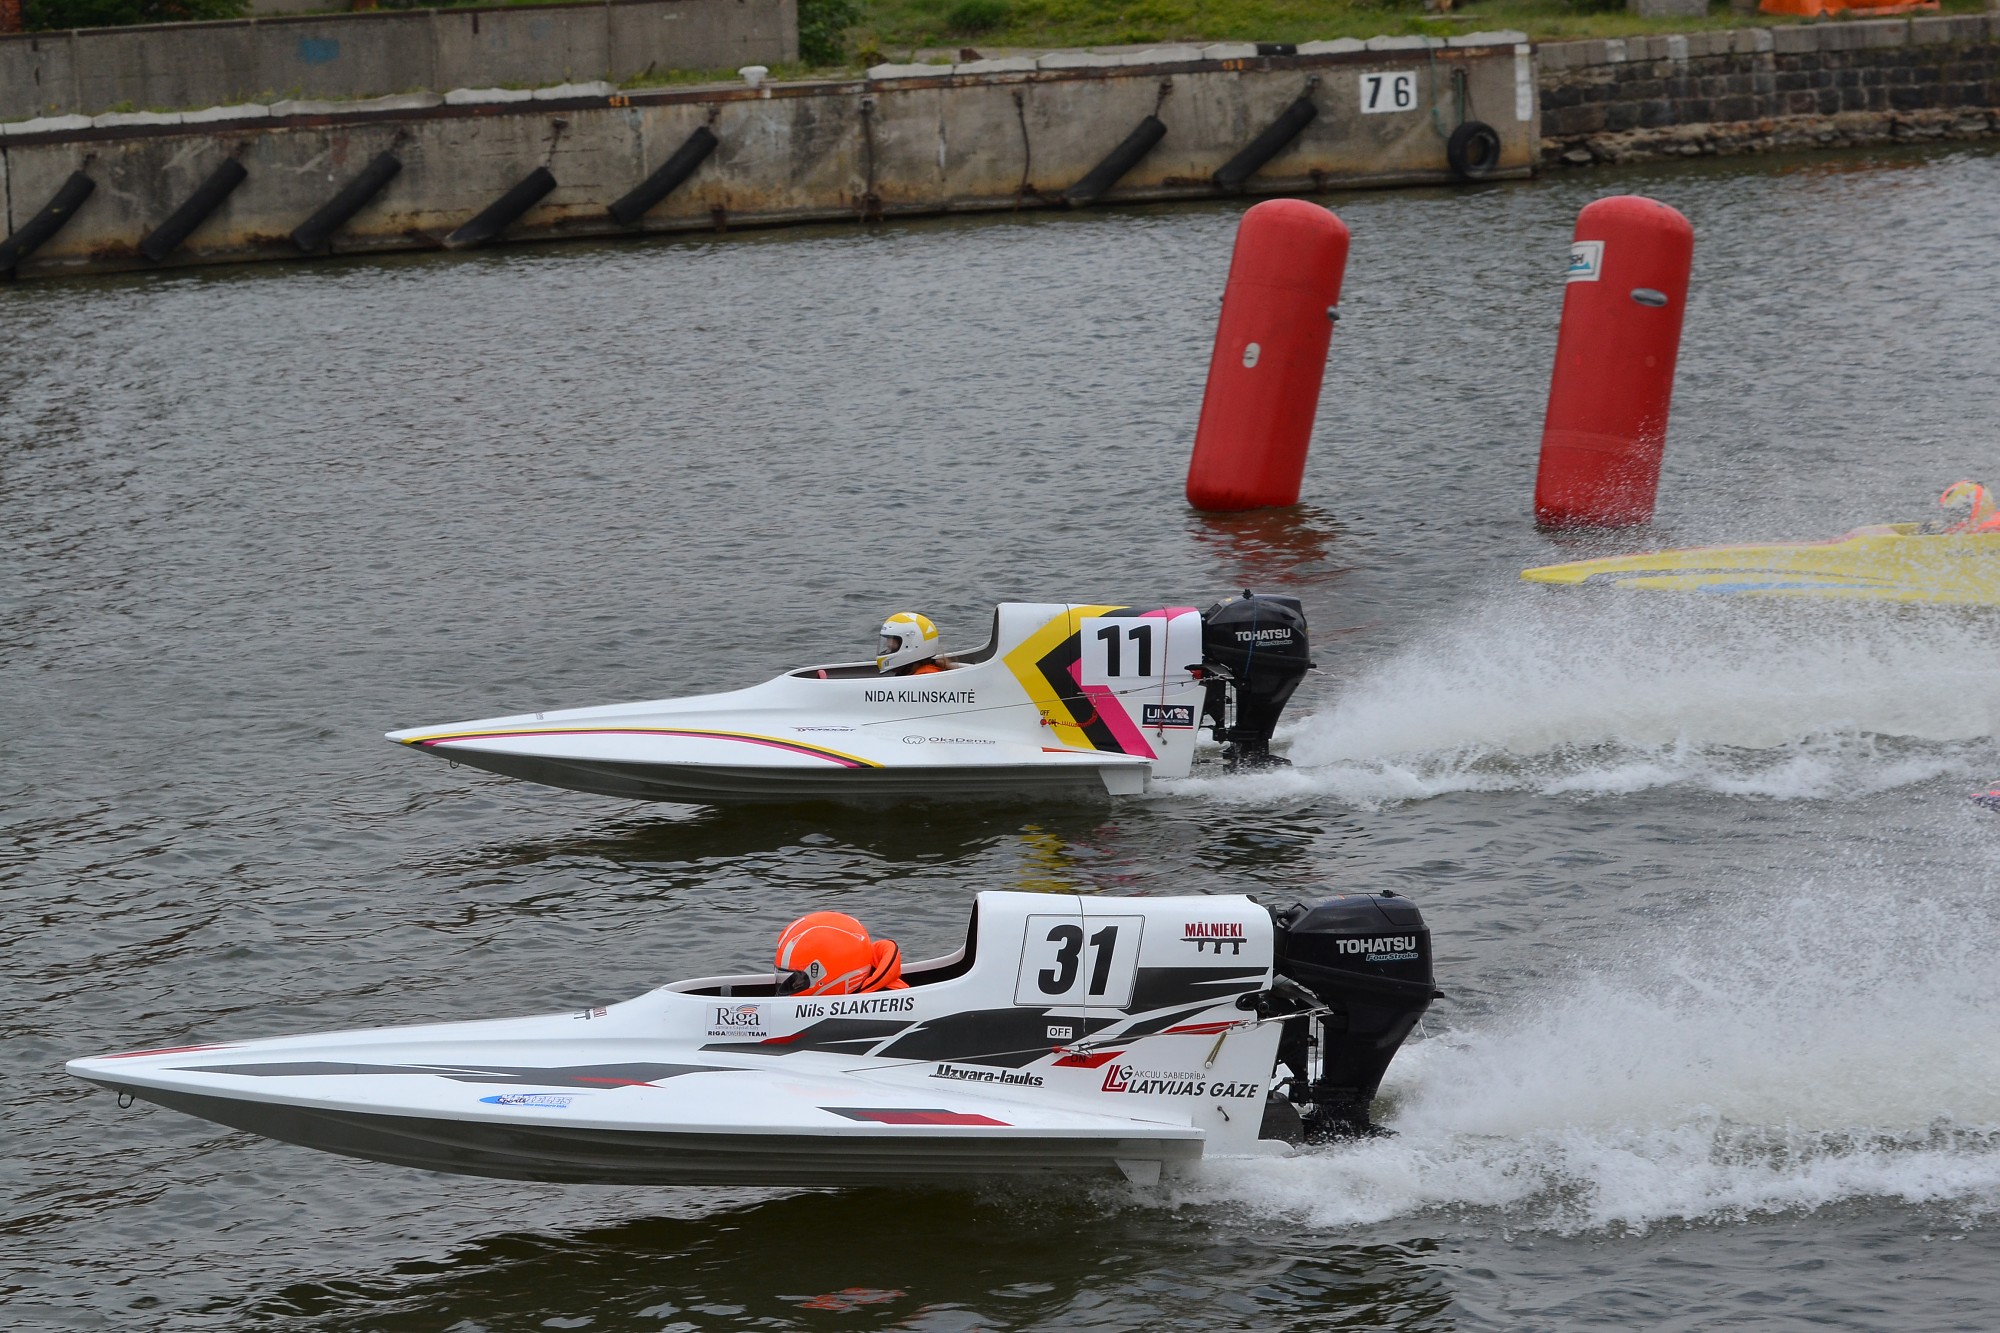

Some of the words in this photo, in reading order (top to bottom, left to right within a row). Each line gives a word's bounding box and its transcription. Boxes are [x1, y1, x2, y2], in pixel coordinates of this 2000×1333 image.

[1235, 628, 1291, 642] TOHATSU
[1097, 624, 1151, 677] 11
[864, 690, 895, 703] NIDA
[898, 688, 976, 704] KILINSKAITĖ
[1146, 707, 1174, 719] UIM
[1184, 921, 1243, 937] MĀLNIEKI
[1335, 935, 1416, 954] TOHATSU
[1037, 923, 1119, 996] 31
[1365, 951, 1419, 961] FourStroke
[795, 1003, 825, 1018] Nils
[829, 996, 915, 1016] SLAKTERIS
[1049, 1027, 1071, 1037] OFF
[1070, 1054, 1087, 1064] ON
[936, 1063, 1044, 1087] Uzvara-lauks
[1127, 1079, 1207, 1097] LATVIJAS
[1209, 1080, 1259, 1099] GĀZE
